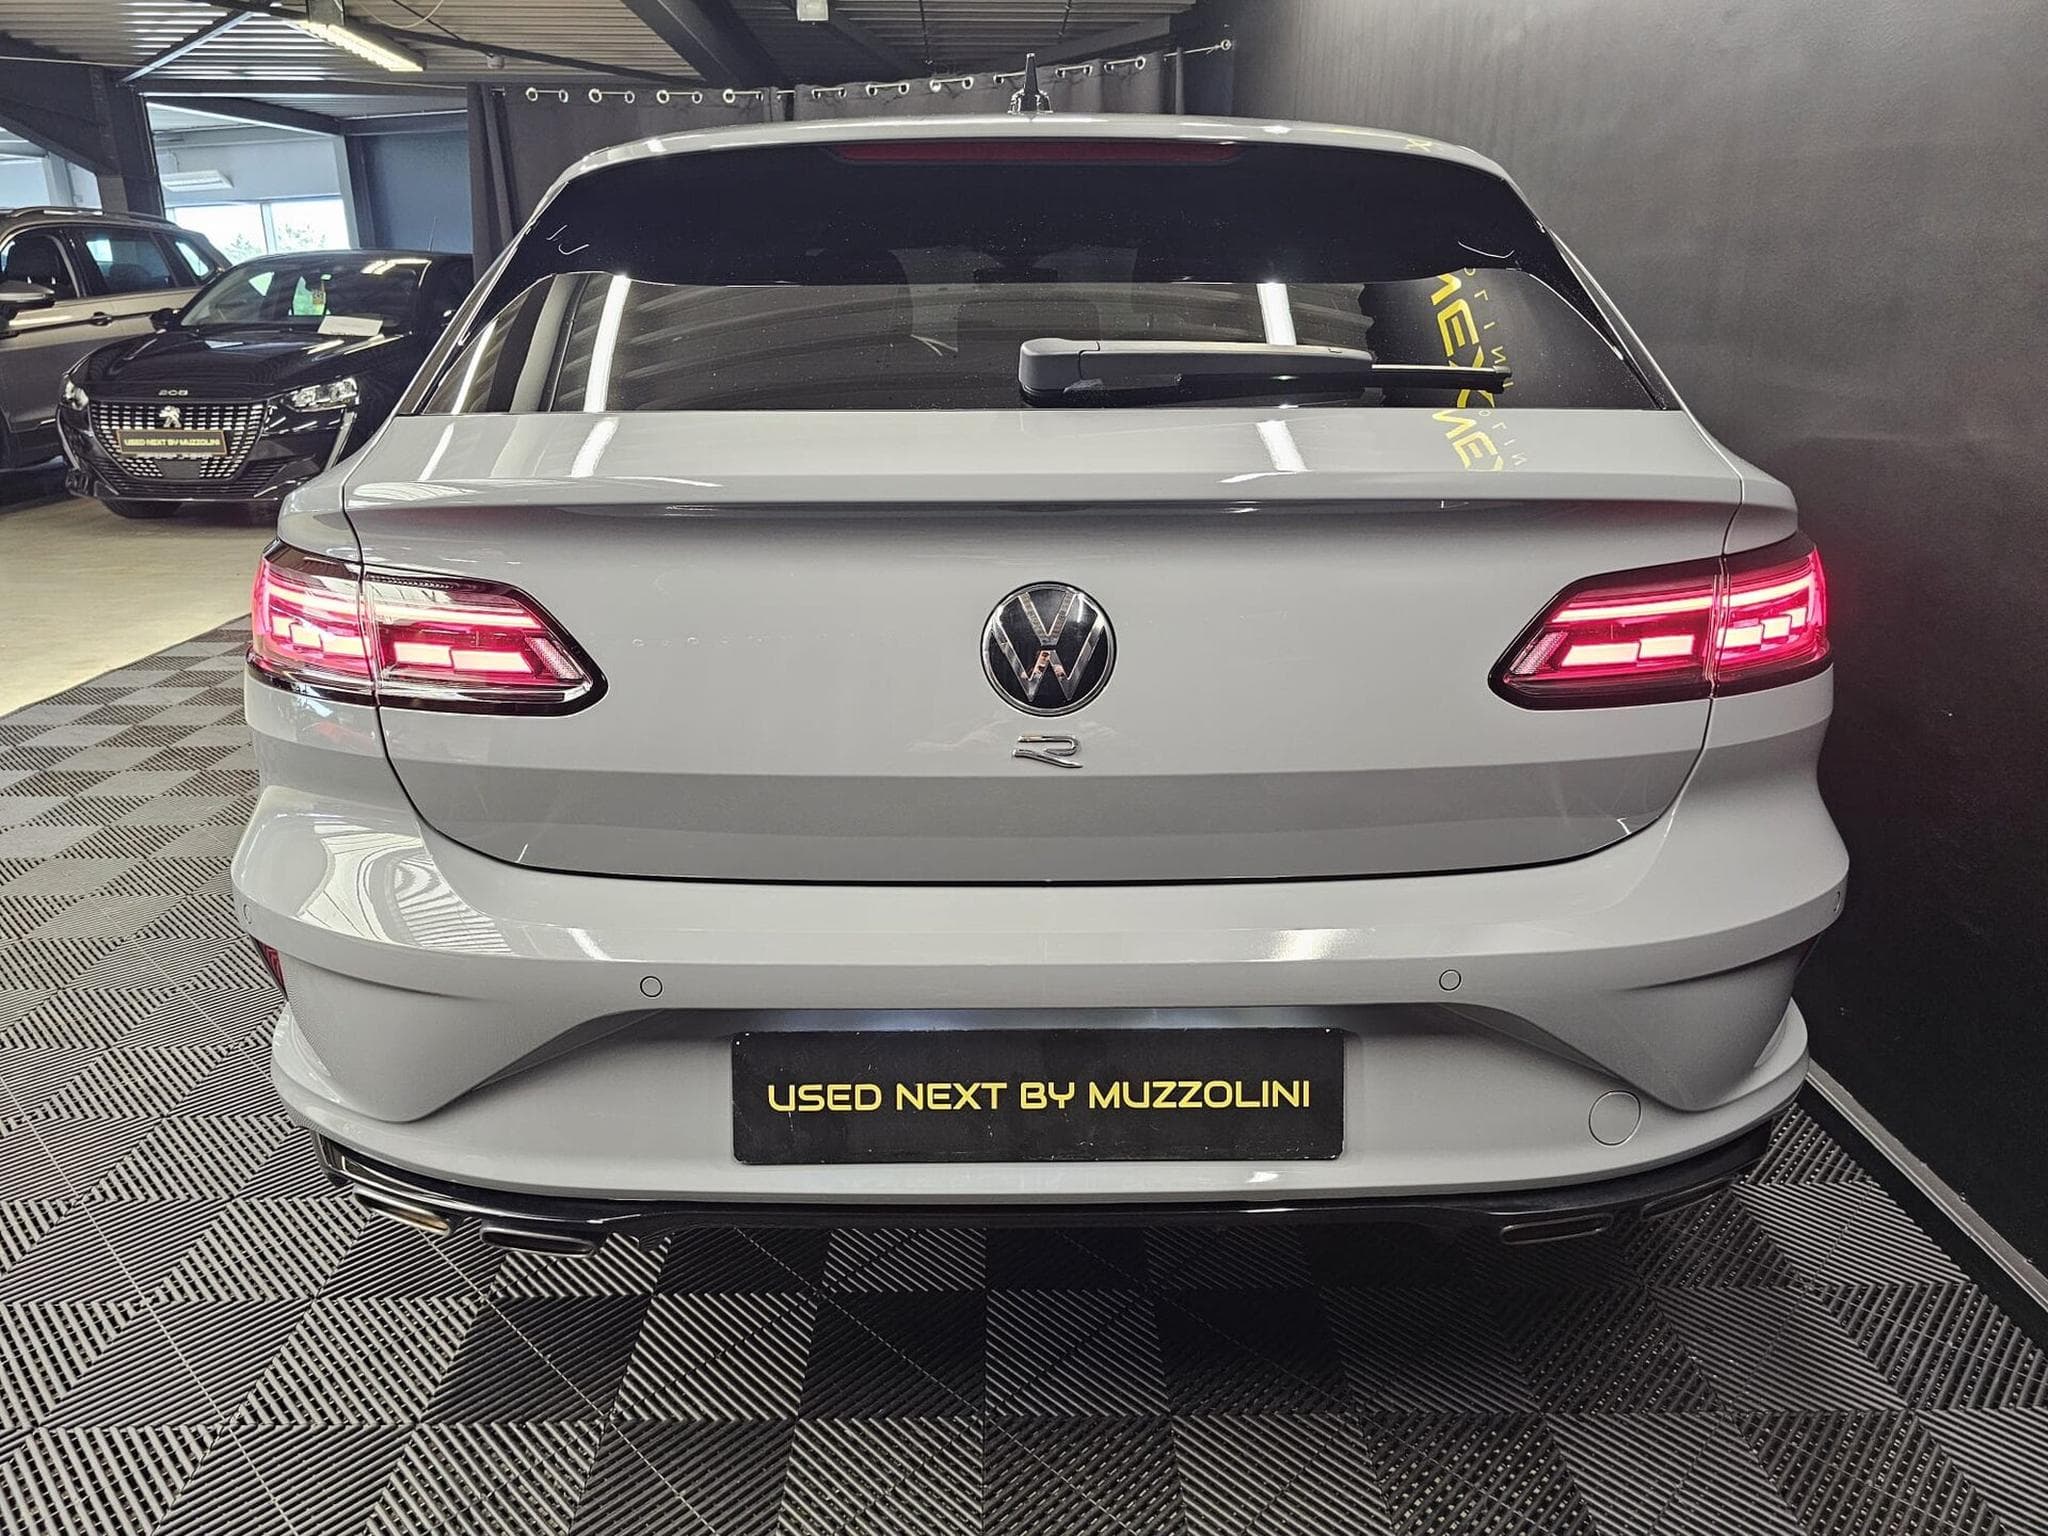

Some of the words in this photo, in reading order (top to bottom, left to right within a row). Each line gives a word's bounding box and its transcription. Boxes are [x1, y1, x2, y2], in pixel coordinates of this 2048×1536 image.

[767, 1083, 882, 1112] USED
[896, 1082, 1008, 1111] NEXT
[1020, 1081, 1076, 1110] BY
[1089, 1080, 1310, 1109] MUZZOLINI
